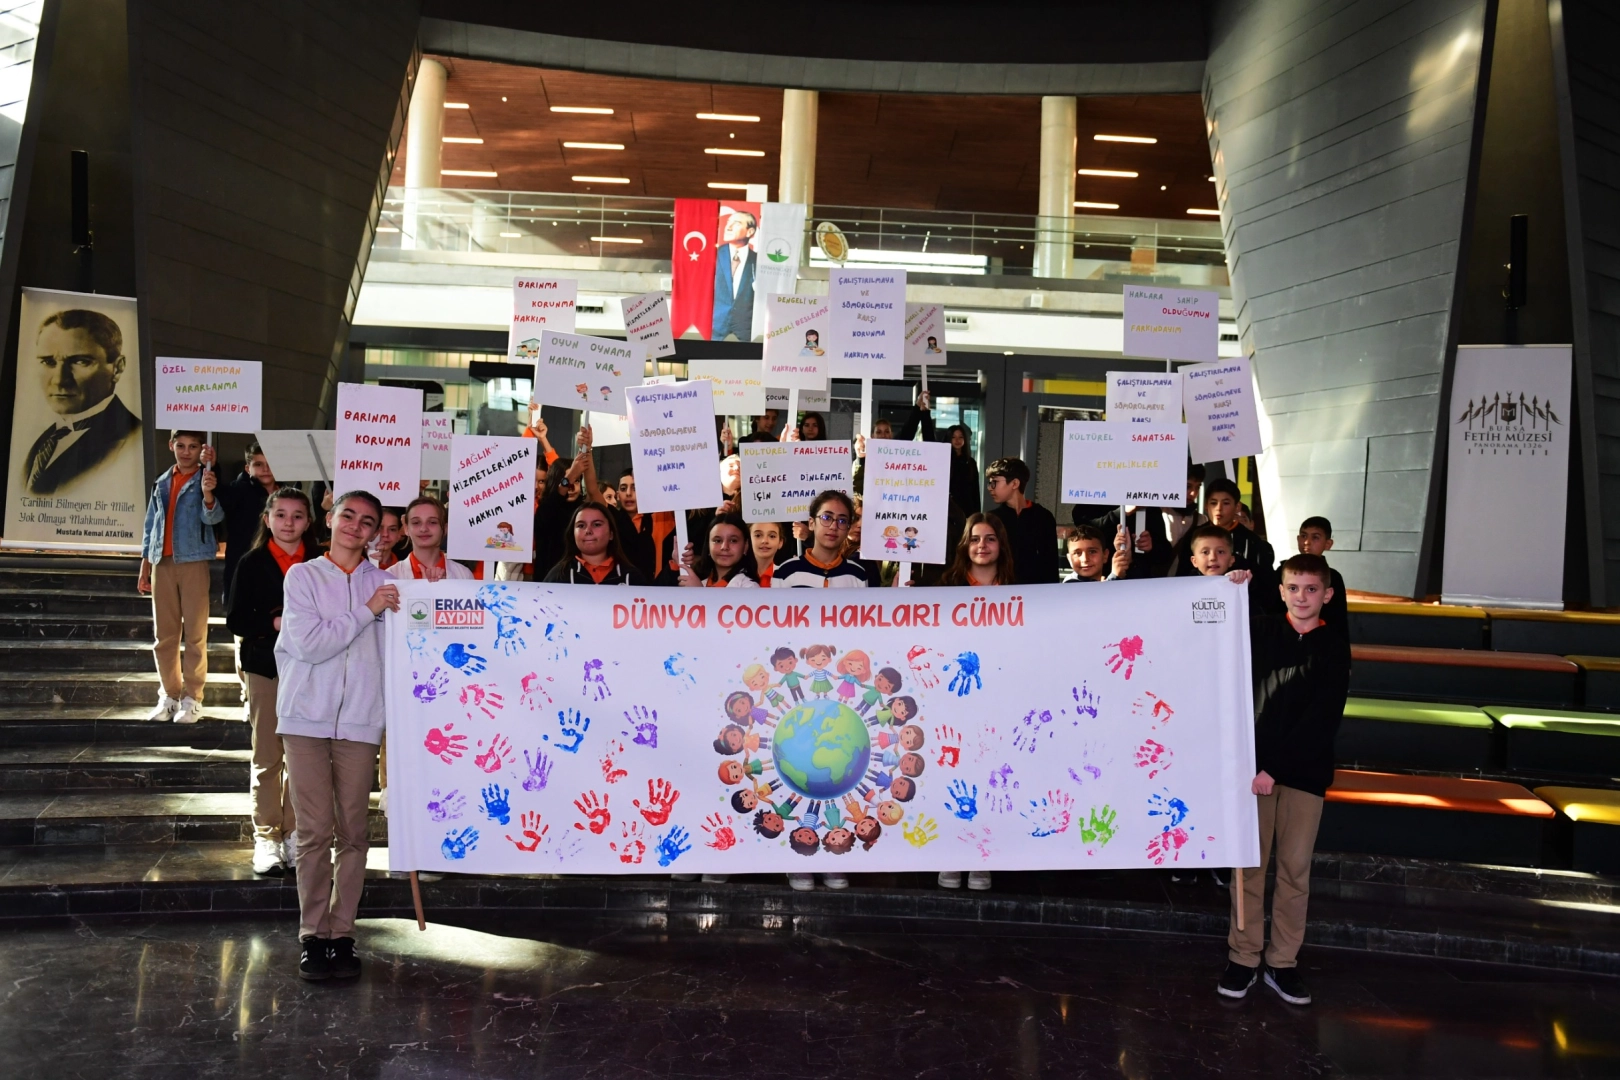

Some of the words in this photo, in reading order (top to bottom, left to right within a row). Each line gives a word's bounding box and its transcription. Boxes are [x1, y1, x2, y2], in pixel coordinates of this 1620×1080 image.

[518, 281, 557, 289] BARINMA
[839, 277, 894, 285] ÇALIŞTIRILMAYA
[1129, 291, 1163, 300] HAKLARA
[1177, 296, 1198, 304] SAHİP
[795, 306, 828, 326] BESLENME
[1162, 307, 1210, 318] OLDUĞUMUN
[514, 315, 546, 323] HAKKIM
[1131, 325, 1182, 333] FARKINDAYIM
[552, 337, 578, 349] OYUN
[590, 343, 632, 358] OYNAMA
[549, 356, 586, 369] HAKKIM
[595, 362, 614, 372] VAR
[162, 365, 186, 374] ÖZEL
[194, 366, 241, 375] BAKIMDAN
[176, 382, 237, 393] YARARLANMA
[1117, 379, 1172, 387] ÇALIŞTIRILMAYA
[635, 390, 698, 404] ÇALIŞTIRILMAYA
[166, 403, 205, 412] HAKKINA
[210, 402, 248, 413] SAHİBİM
[344, 411, 396, 424] BARINMA
[1208, 411, 1239, 420] KORUNMA
[355, 434, 411, 446] KORUNMA
[1464, 431, 1500, 441] FETİH
[1505, 431, 1552, 442] MÜZESİ
[644, 447, 665, 457] KARŞI
[670, 442, 708, 452] KORUNMA
[744, 447, 787, 456] KÜLTÜREL
[794, 445, 848, 455] FAALİYETLER
[878, 447, 921, 456] KÜLTÜREL
[460, 447, 492, 469] SAĞLIK
[341, 460, 383, 471] HAKKIM
[452, 447, 530, 492] HİZMETLERİNDEN
[657, 462, 685, 472] HAKKIM
[885, 462, 927, 471] SANATSAL
[1097, 461, 1158, 469] ETKİNLİKLERE
[749, 474, 787, 484] EĞLENCE
[875, 478, 935, 486] ETKİNLİKLERE
[379, 481, 400, 491] VAR
[463, 472, 524, 507] YARARLANMA
[753, 492, 771, 501] İÇİN
[781, 489, 816, 498] ZAMANA
[882, 493, 920, 502] KATILMA
[1069, 490, 1106, 498] KATILMA
[1126, 492, 1159, 500] HAKKIM
[20, 497, 53, 508] Tarihini
[55, 499, 91, 512] Bilmeyen
[94, 500, 108, 511] Bir
[111, 502, 135, 512] Millet
[786, 504, 809, 514] HAKK
[468, 506, 503, 527] HAKKIM
[508, 494, 527, 507] VAR
[875, 512, 908, 520] HAKKIM
[18, 512, 34, 522] Yok
[38, 513, 66, 526] Olmaya
[435, 599, 484, 610] ERKAN
[1192, 600, 1225, 610] KÜLTÜR
[437, 612, 482, 624] AYDIN
[612, 598, 706, 629] DÜNYA
[717, 603, 810, 634] ÇOCUK
[820, 602, 940, 628] HAKLARI
[952, 596, 1024, 627] GÜNÜ
[1196, 611, 1223, 619] SANAT
